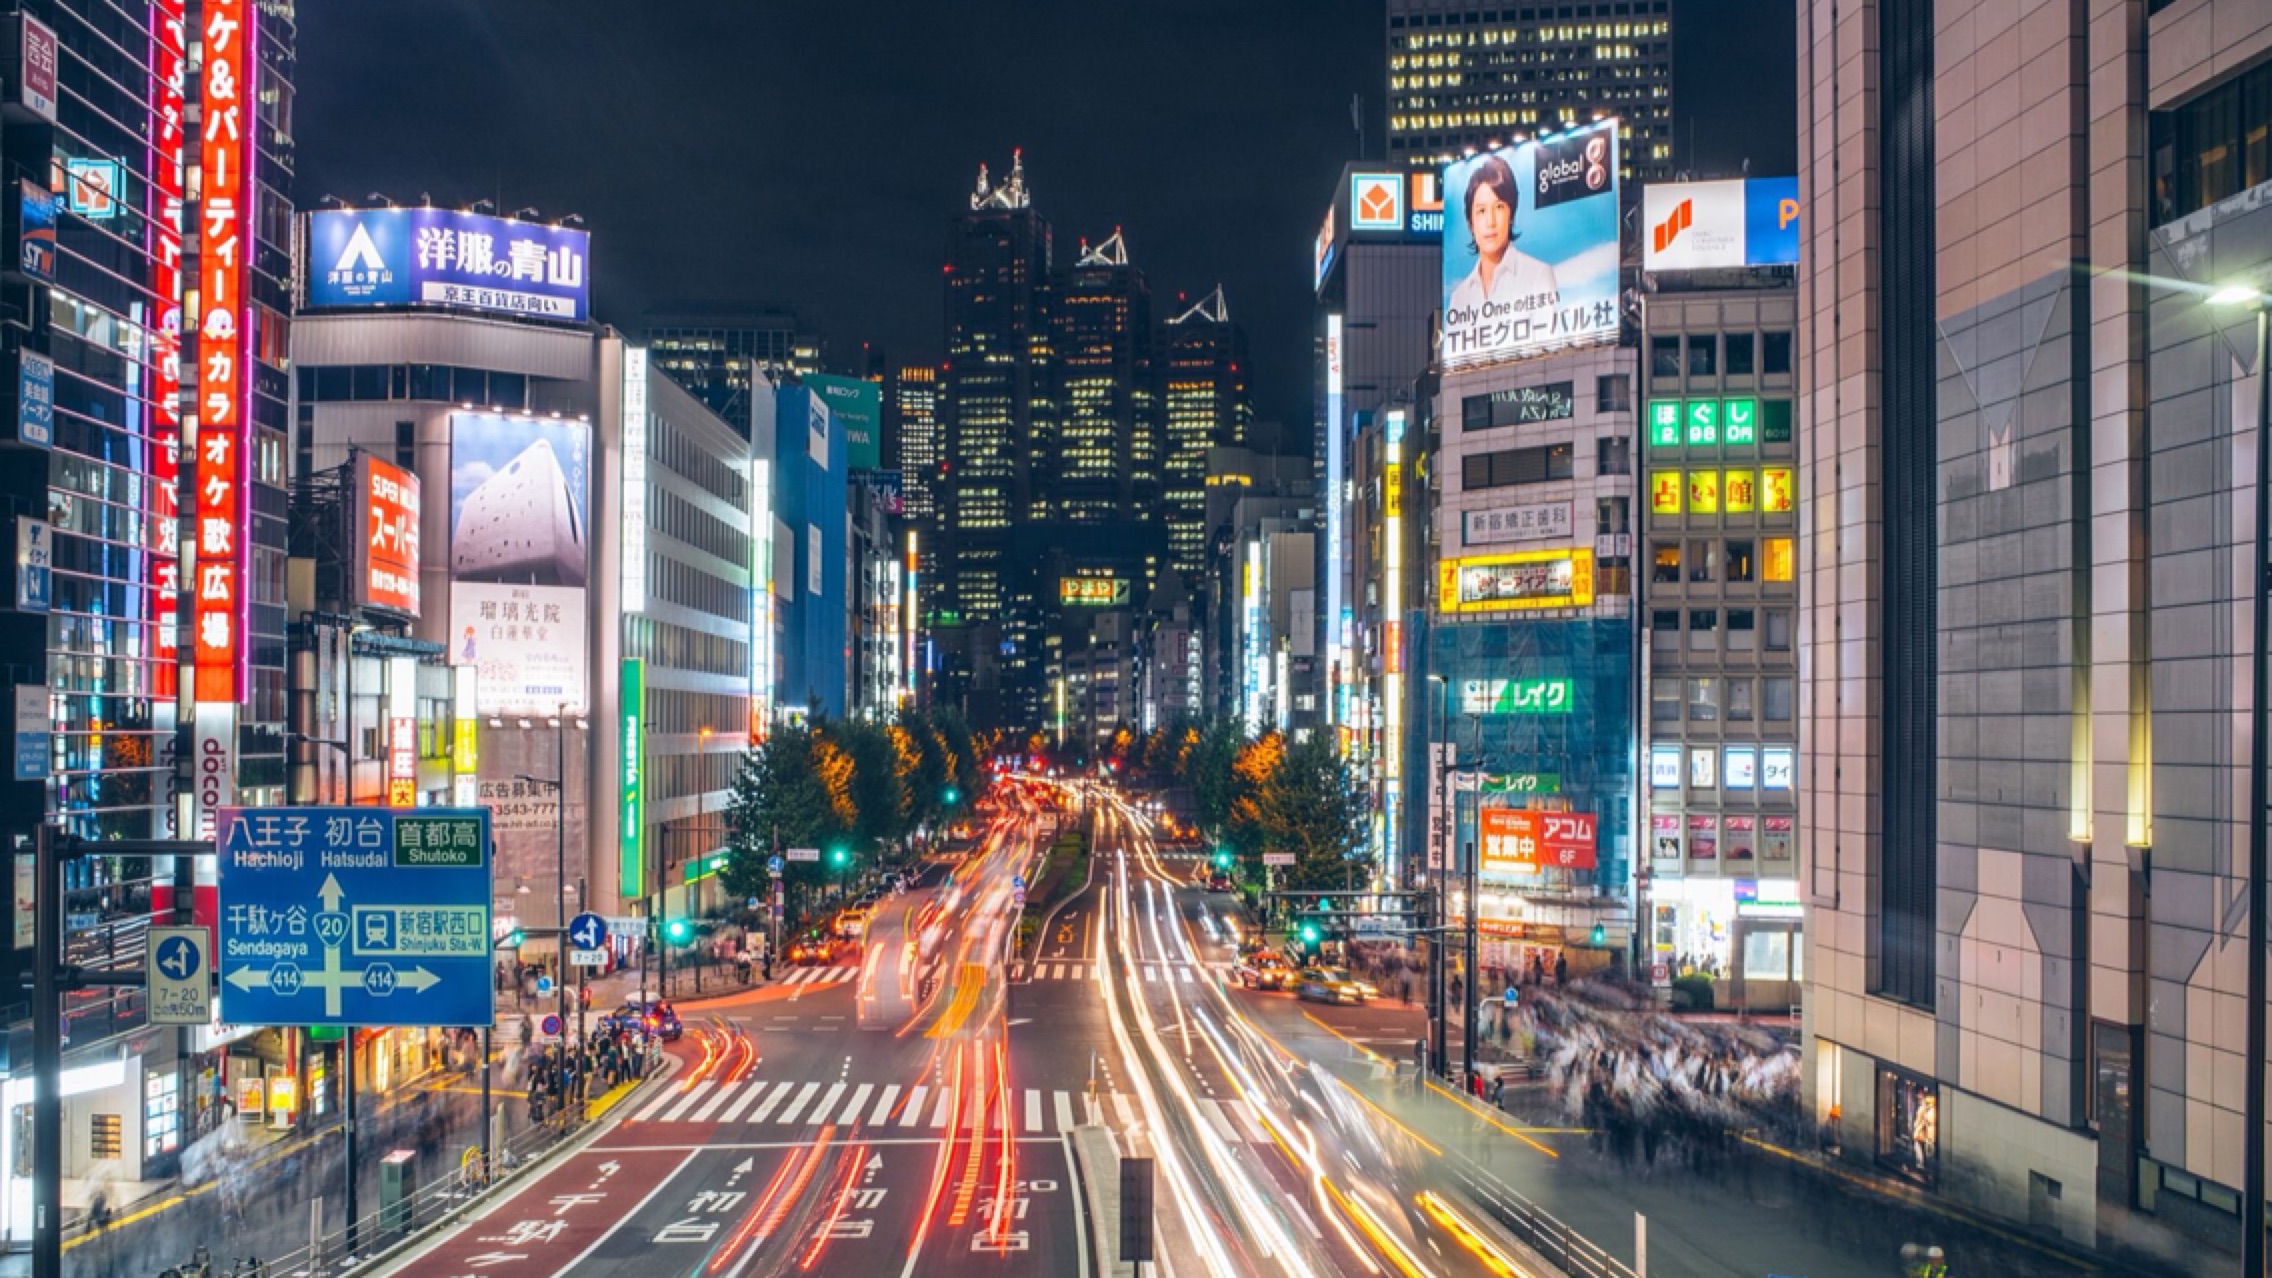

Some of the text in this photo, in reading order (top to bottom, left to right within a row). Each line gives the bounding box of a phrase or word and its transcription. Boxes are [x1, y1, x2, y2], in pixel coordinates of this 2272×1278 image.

[1540, 153, 1585, 194] global
[417, 227, 583, 288] 洋服の青山
[444, 286, 560, 312] 京王百貨店向い
[1447, 291, 1560, 326] Only One の住まい
[1448, 300, 1614, 353] THEグローバル社
[1656, 402, 1749, 425] ほぐし
[480, 600, 560, 623] 瑠璃光院
[1513, 682, 1565, 707] レイク
[480, 782, 557, 798] 広告募集中
[1505, 774, 1537, 792] レイク
[226, 816, 477, 848] 八王子 初台 首都高
[1543, 817, 1591, 840] アコム
[1486, 834, 1535, 859] 営業中
[1559, 849, 1576, 864] 6F
[234, 848, 467, 871] Hachioji Hatsudai Shutoko
[321, 918, 343, 937] 20
[400, 911, 482, 935] 新宿駅西口
[227, 938, 309, 960] Sendagaya
[400, 938, 446, 952] Shinjuku
[273, 970, 393, 988] 414 414
[160, 987, 199, 1001] 7-20
[651, 1191, 746, 1243] 初台
